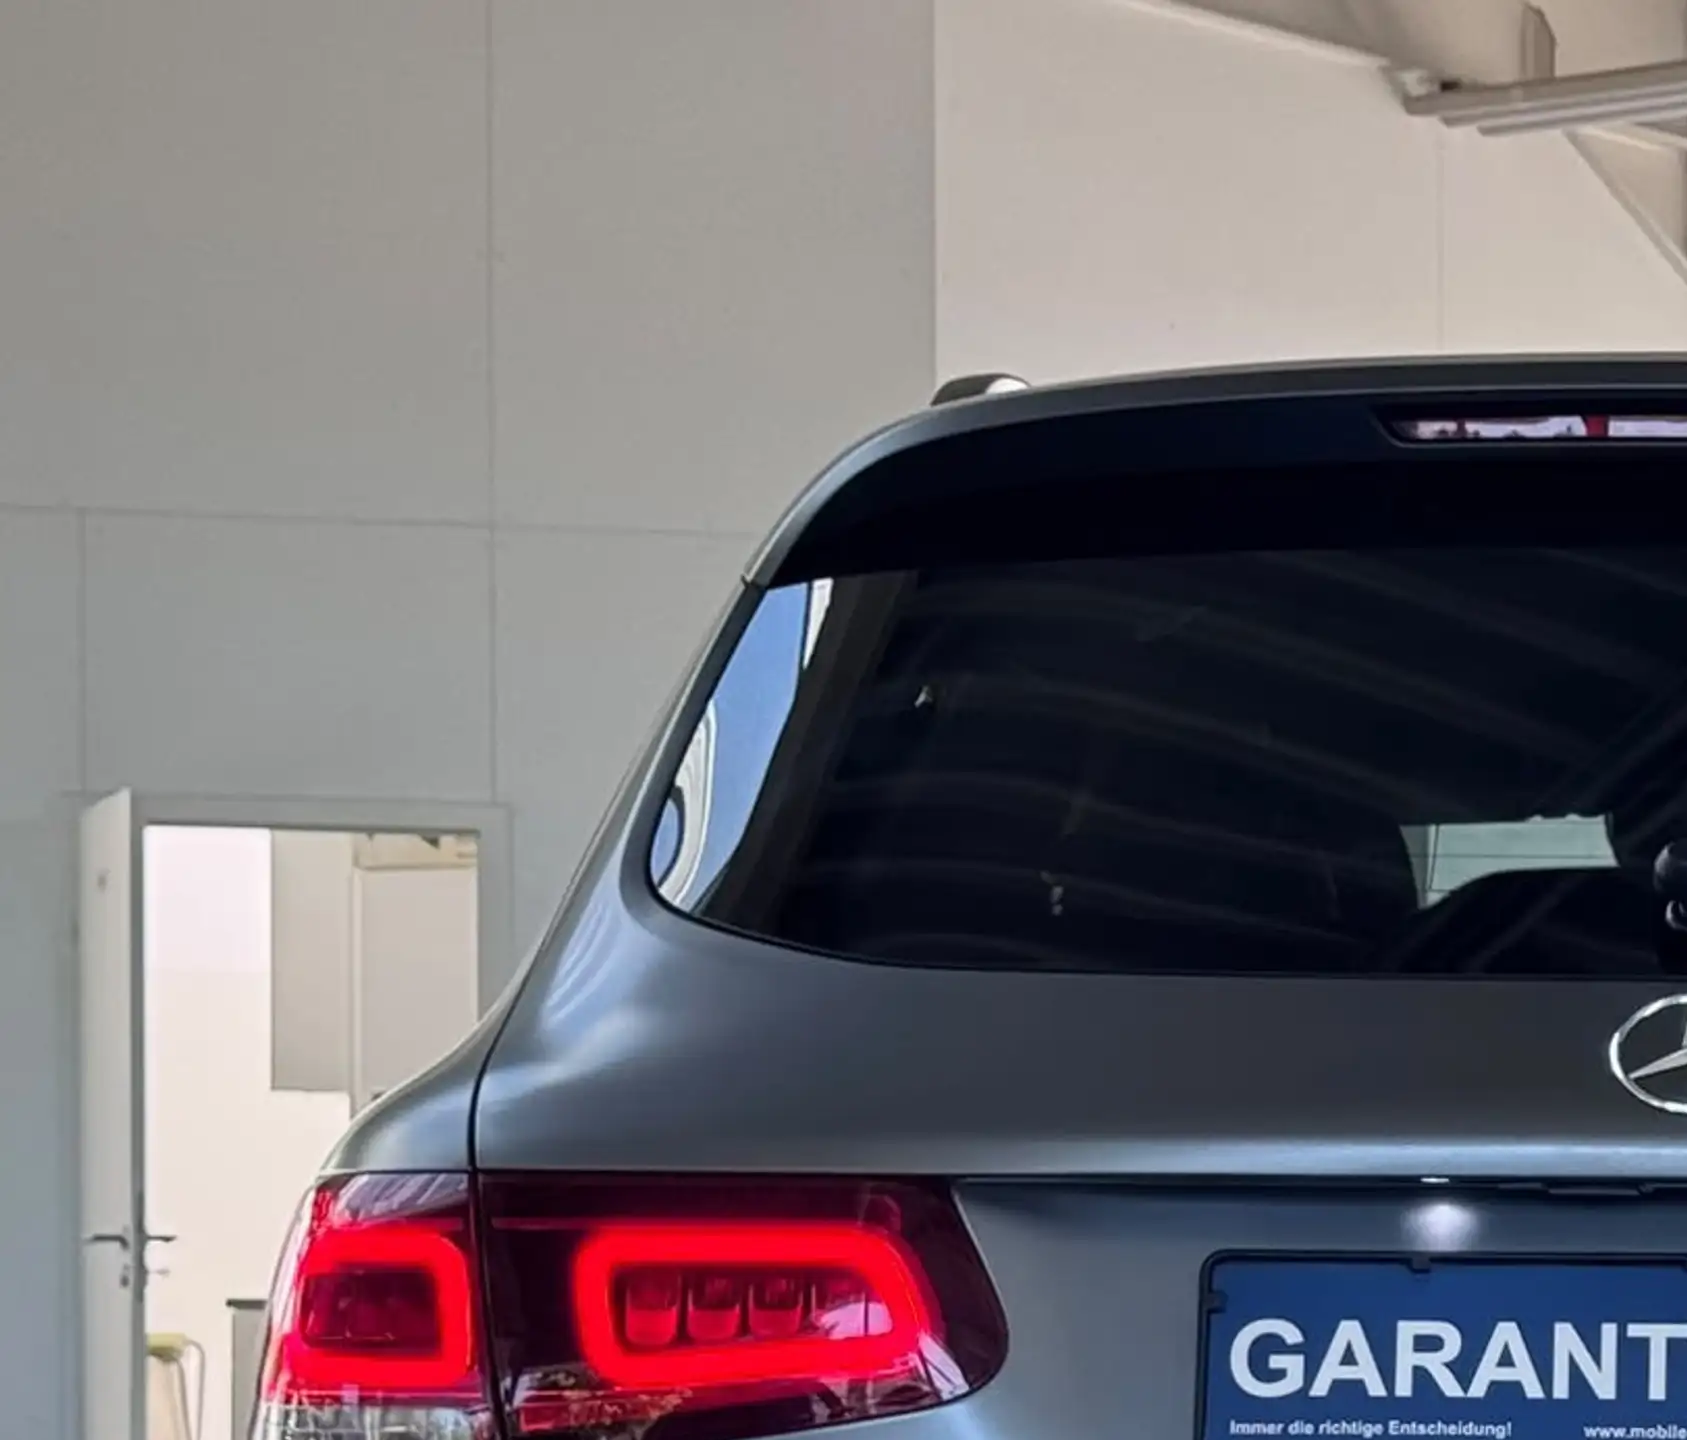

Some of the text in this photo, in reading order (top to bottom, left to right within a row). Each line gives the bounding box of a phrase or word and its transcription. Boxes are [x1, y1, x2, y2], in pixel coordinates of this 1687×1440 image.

[1229, 1419, 1513, 1440] Immer die richtige Entscheidung!
